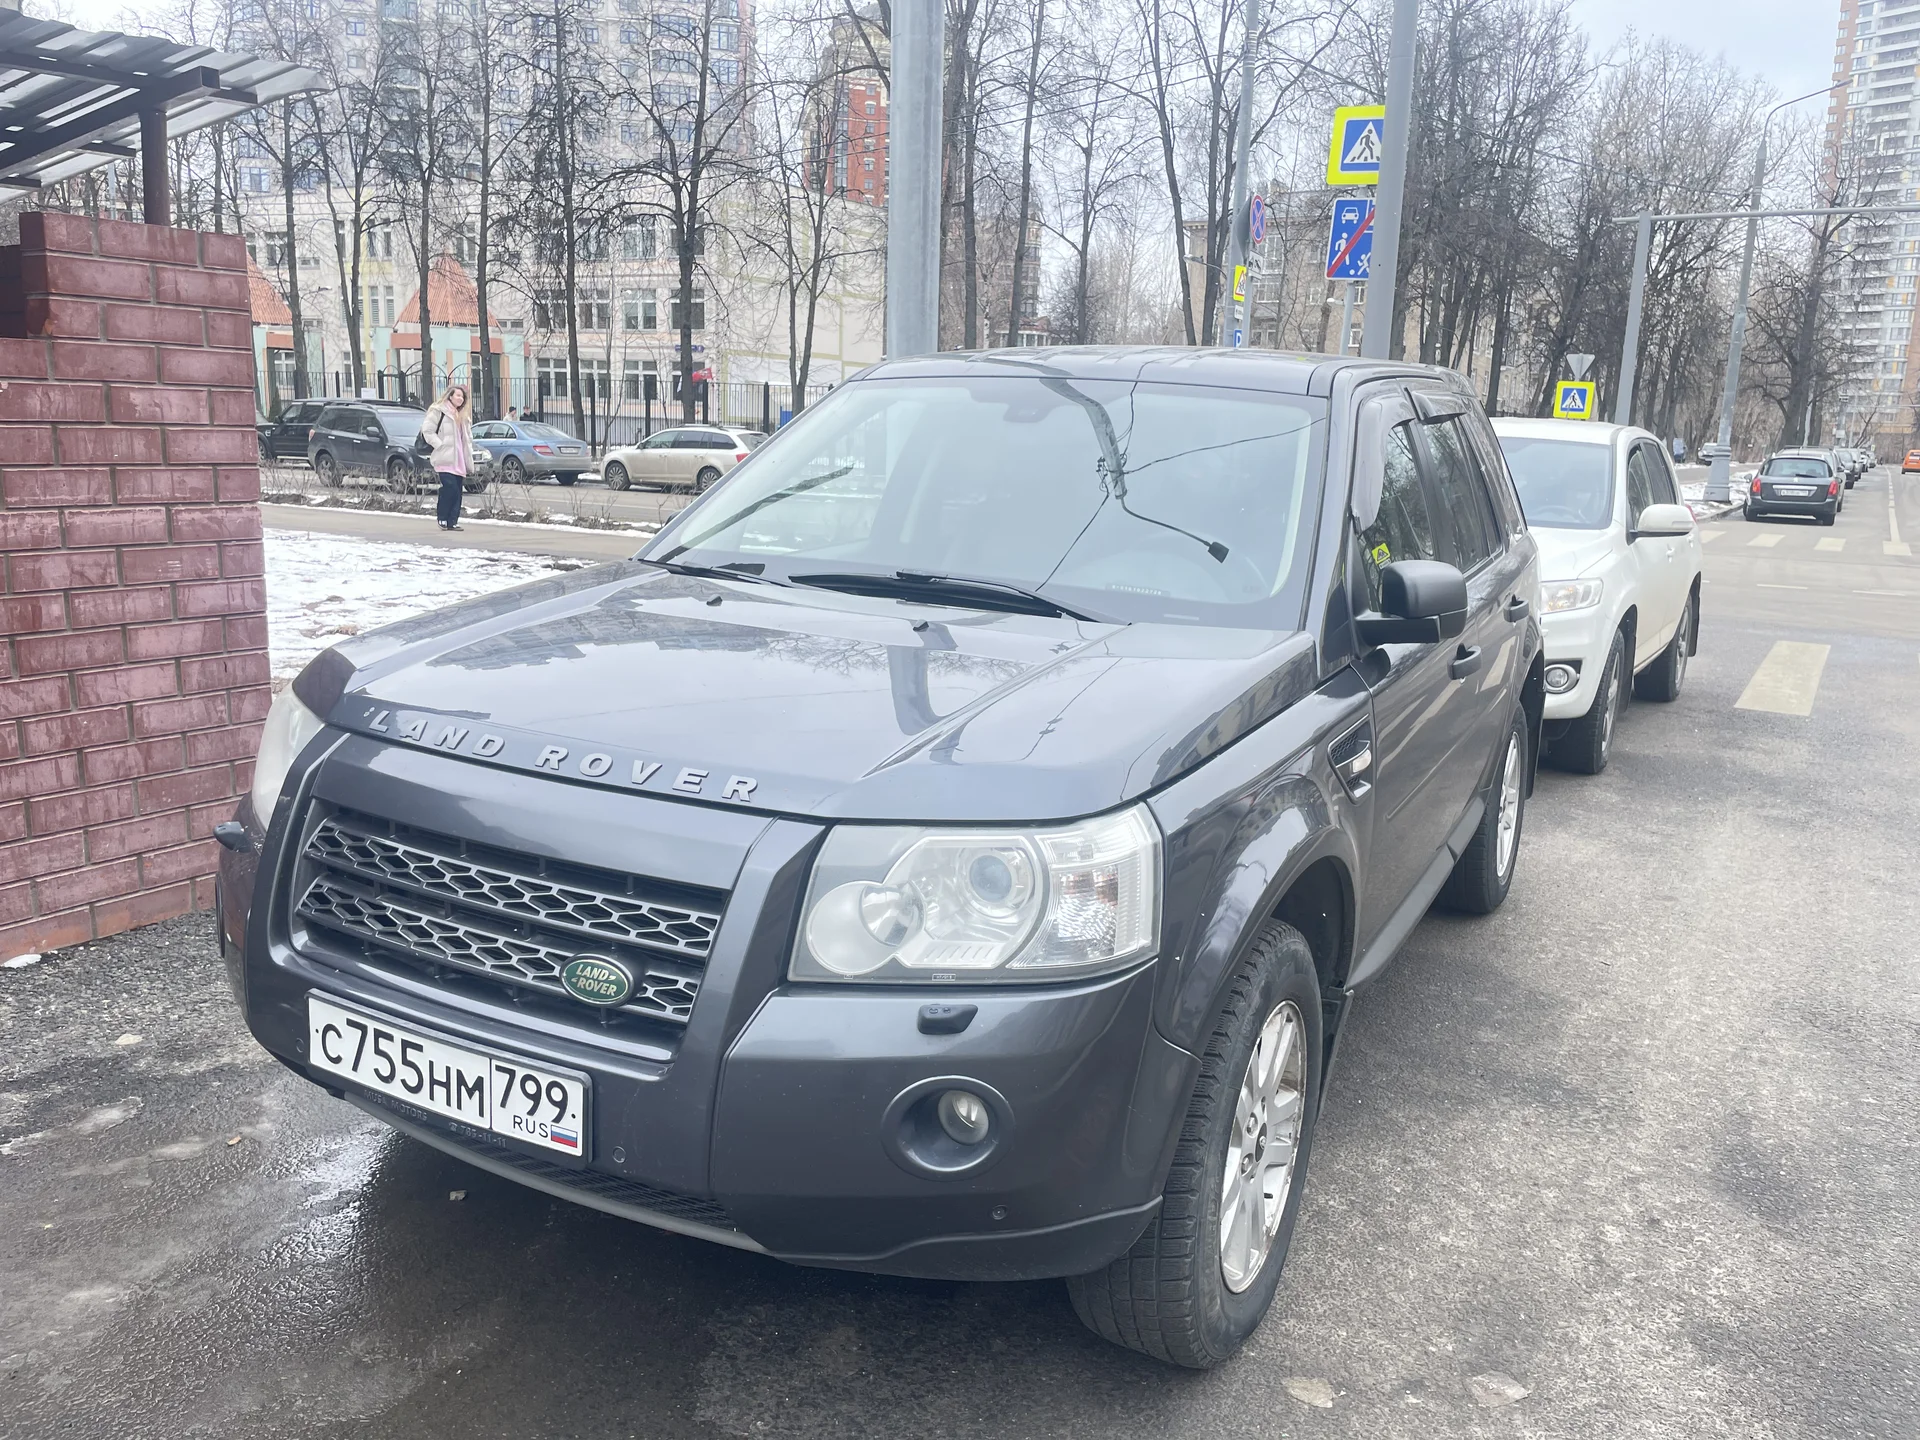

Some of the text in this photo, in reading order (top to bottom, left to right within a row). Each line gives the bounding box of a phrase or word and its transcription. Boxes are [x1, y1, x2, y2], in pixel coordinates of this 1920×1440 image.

[369, 710, 758, 802] LAND ROVER
[576, 964, 608, 980] LAND
[577, 979, 617, 996] ROVER
[495, 1065, 568, 1124] 799
[392, 1100, 428, 1122] MOTORS
[513, 1114, 548, 1138] RUS
